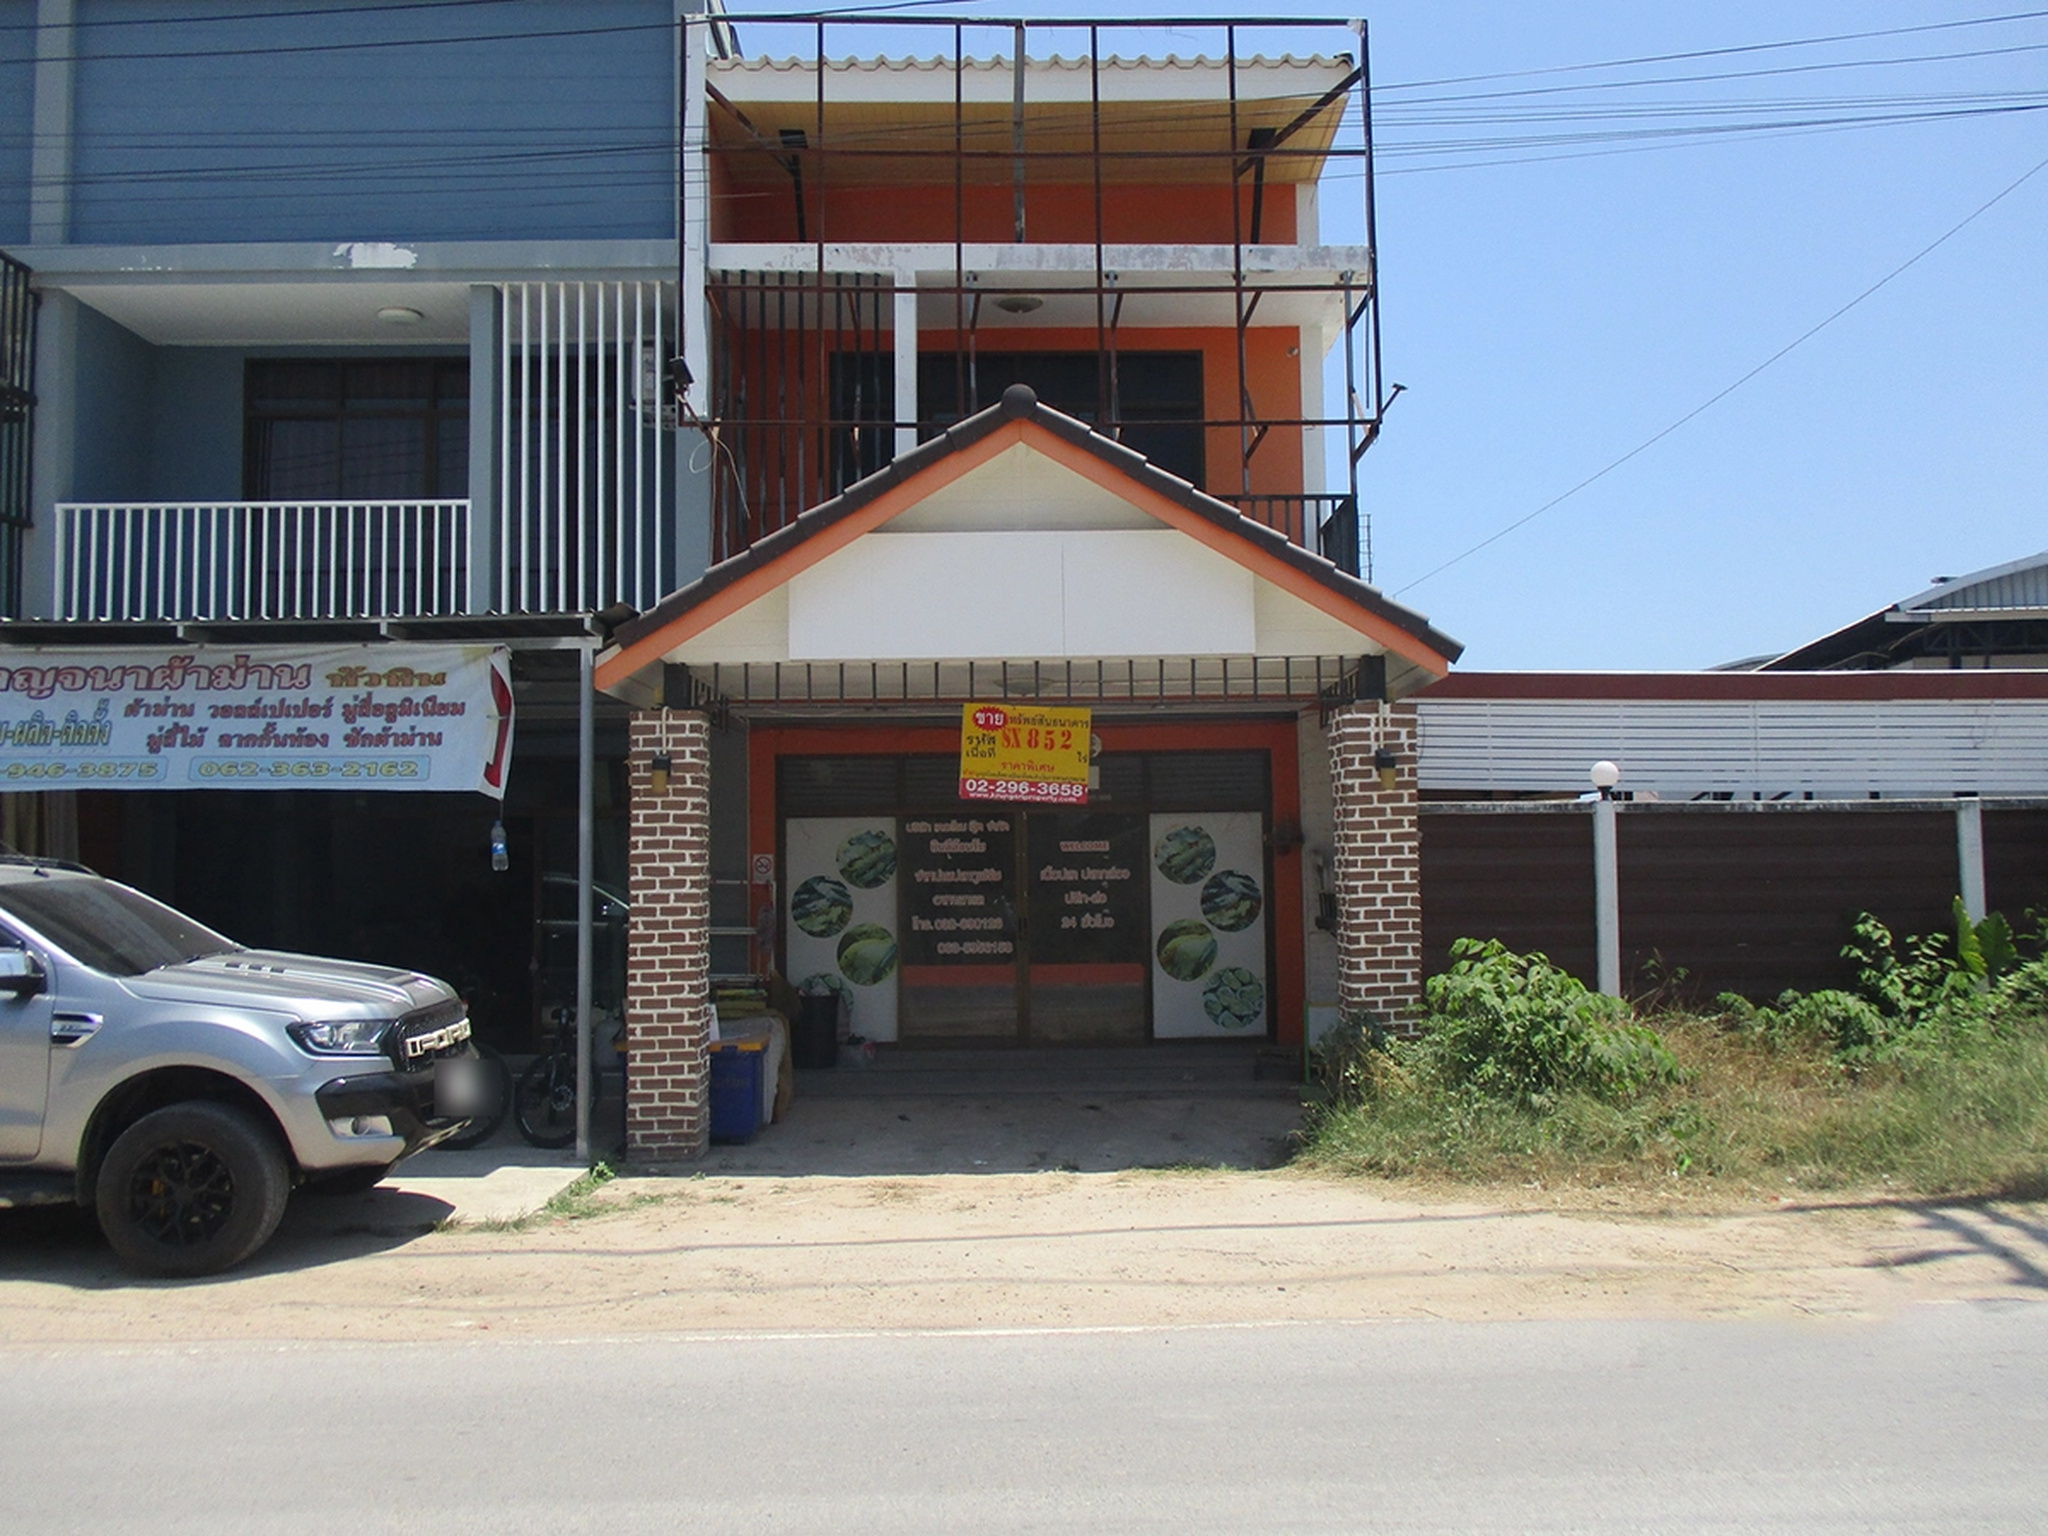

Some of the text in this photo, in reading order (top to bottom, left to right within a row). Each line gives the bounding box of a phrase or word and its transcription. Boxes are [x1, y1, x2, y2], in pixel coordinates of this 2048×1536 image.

[325, 665, 447, 688] หัวหิน
[123, 695, 195, 719] ผ้าม่าน
[975, 711, 1005, 726] ขาย
[966, 733, 997, 745] รหัส
[198, 761, 420, 778] 062-363-2162
[1001, 759, 1055, 773] ราคาพิเศษ
[965, 779, 1084, 797] 02-296-3658
[1059, 840, 1110, 852] WELCOME
